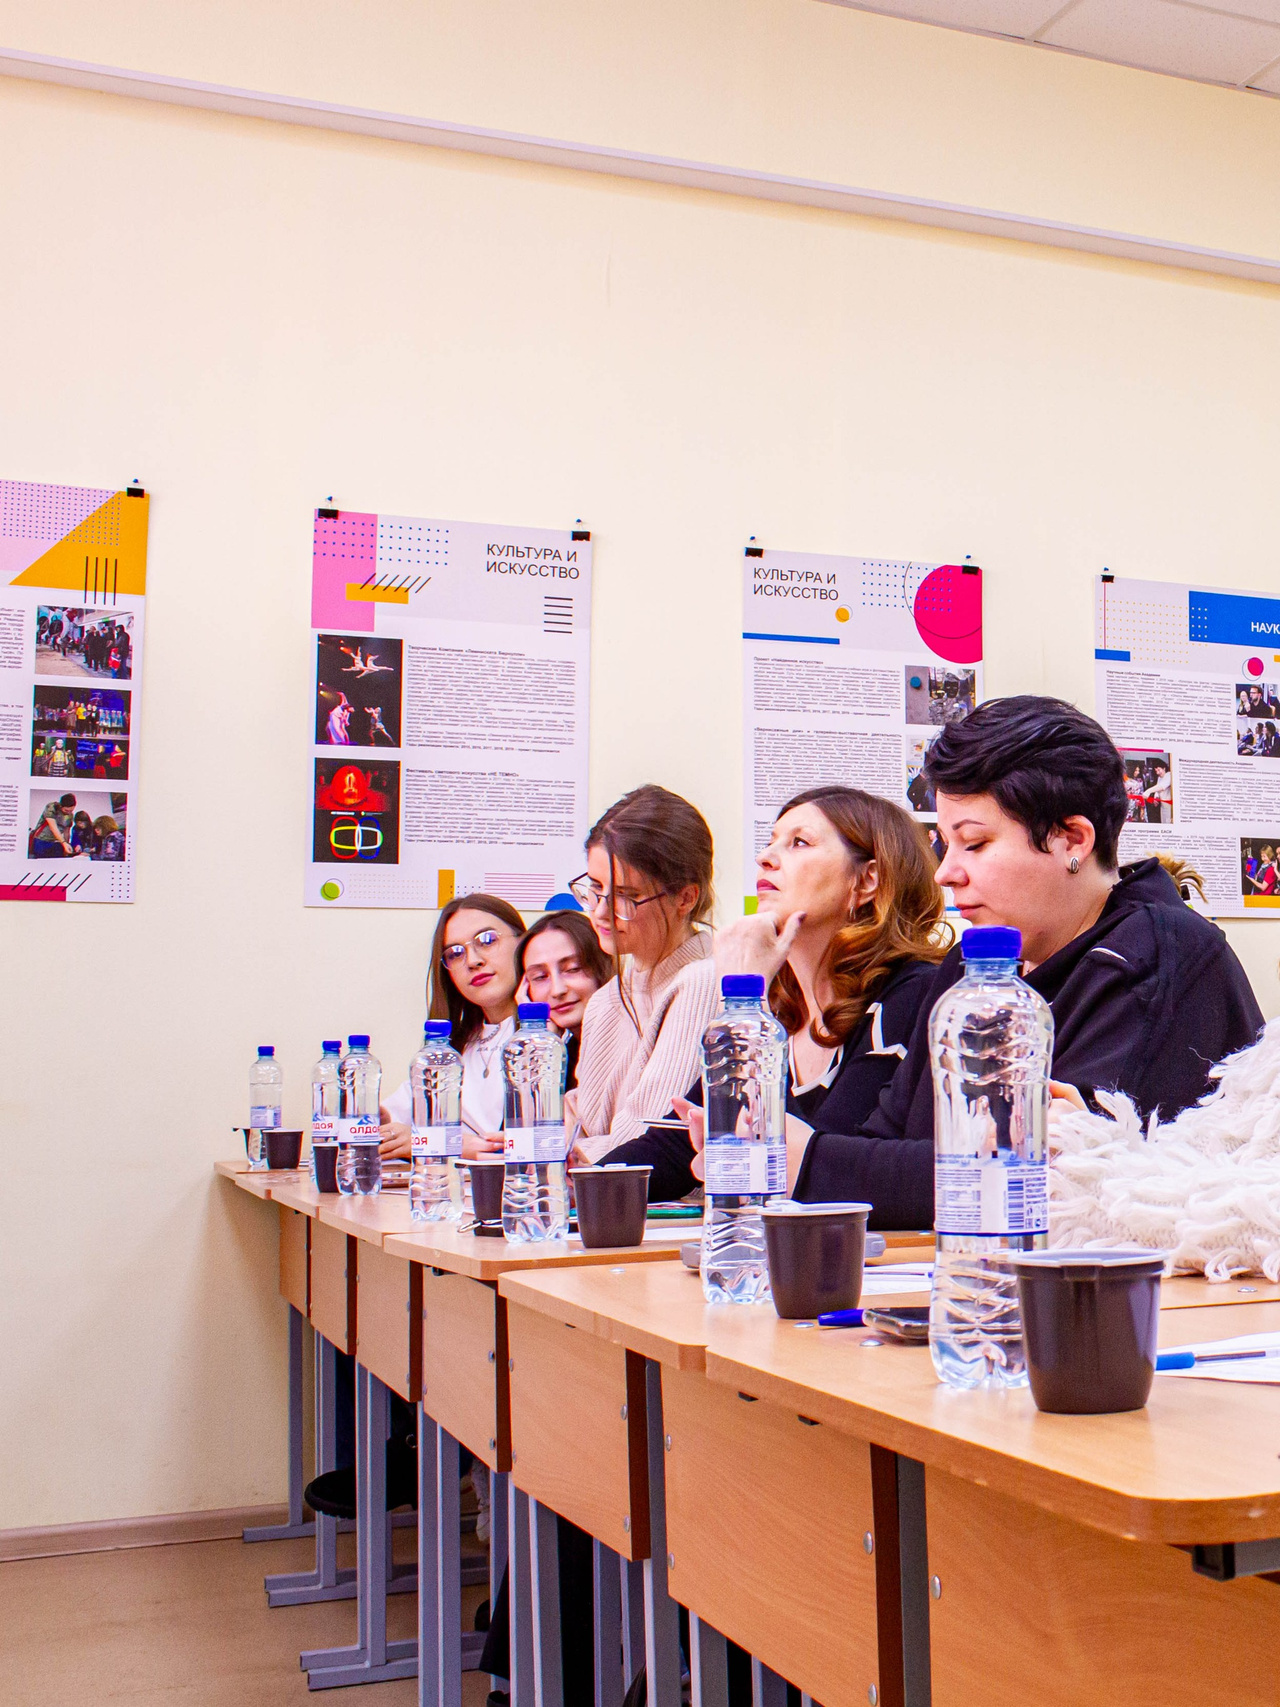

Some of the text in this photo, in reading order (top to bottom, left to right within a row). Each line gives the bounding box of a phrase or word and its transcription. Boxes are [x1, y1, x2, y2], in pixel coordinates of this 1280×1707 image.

[487, 543, 577, 562] КУЛЬТУРА И
[486, 560, 580, 579] ИСКУССТВО
[753, 567, 836, 585] КУЛЬТУРА И
[753, 583, 839, 600] ИСКУССТВО
